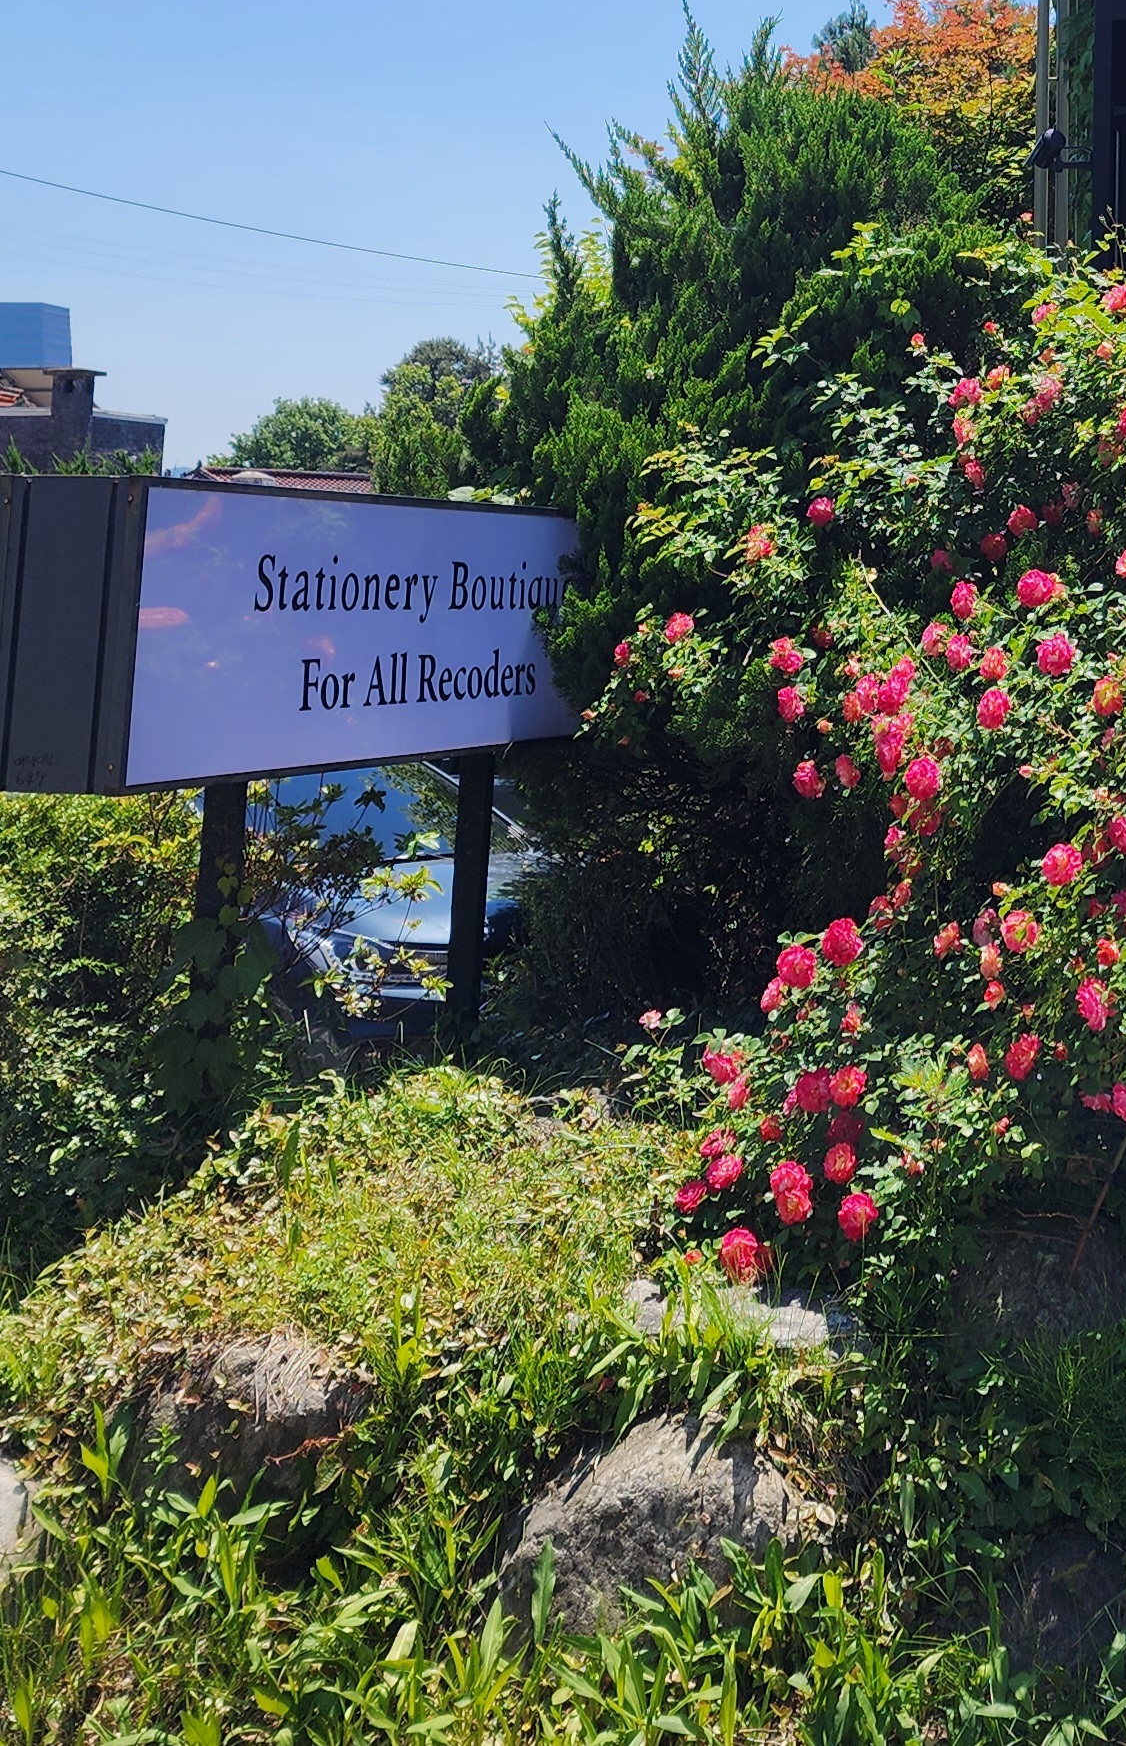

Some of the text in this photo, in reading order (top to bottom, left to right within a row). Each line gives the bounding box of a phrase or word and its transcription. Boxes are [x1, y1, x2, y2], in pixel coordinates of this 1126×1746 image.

[253, 553, 439, 624] Stationery
[298, 648, 537, 712] For All Recoders
